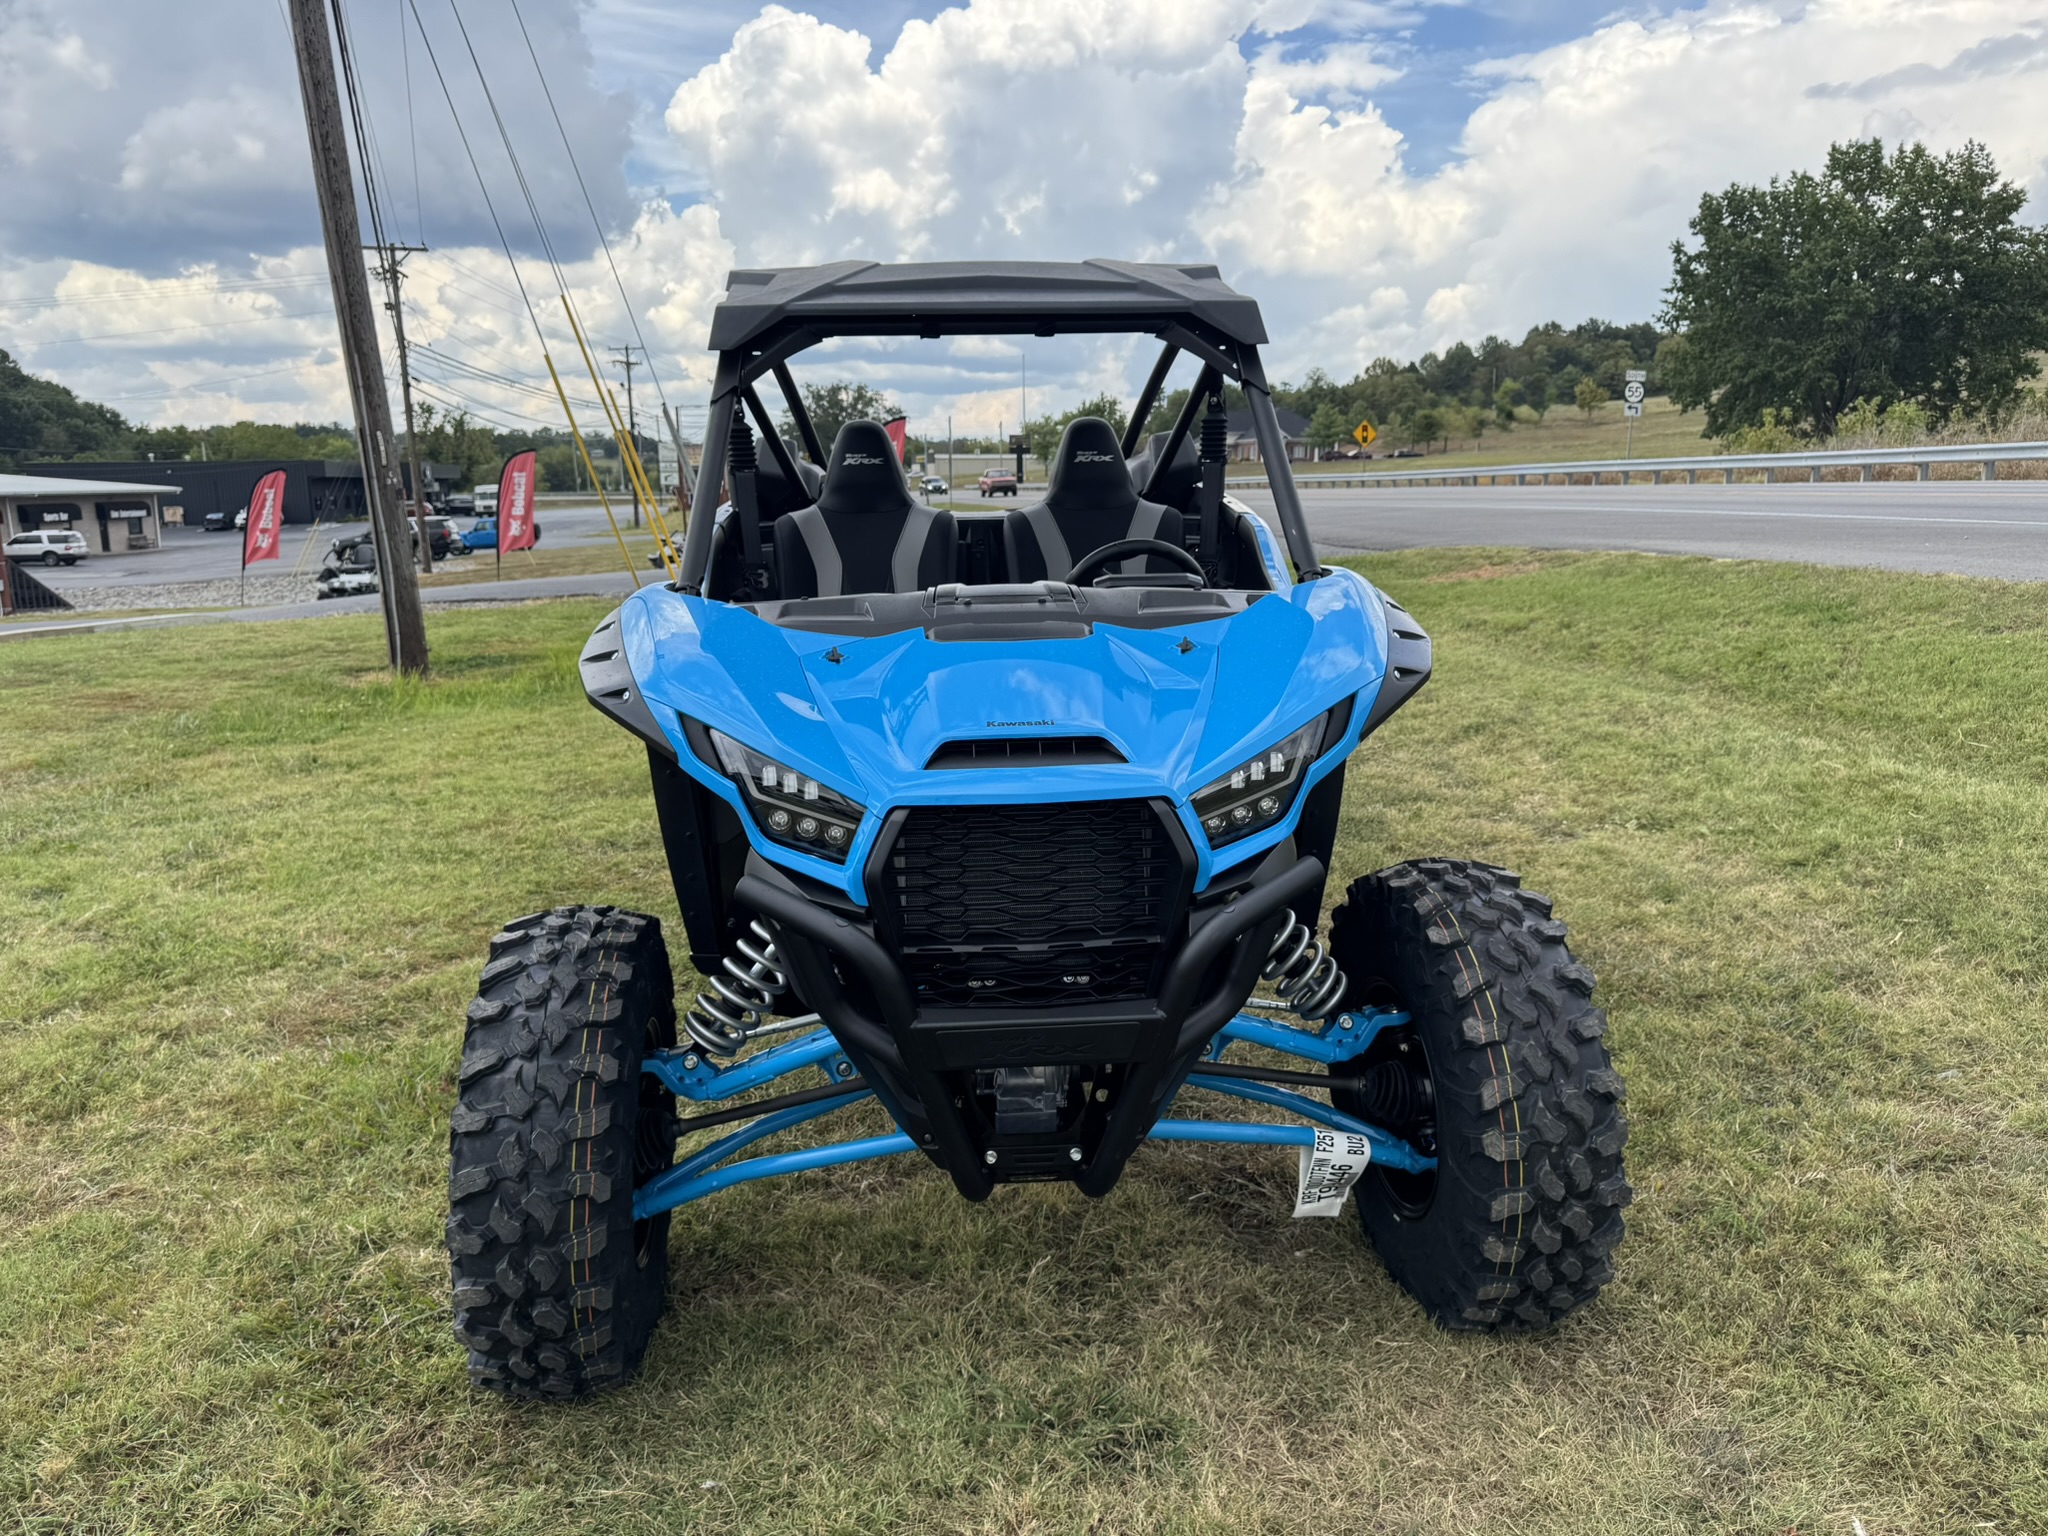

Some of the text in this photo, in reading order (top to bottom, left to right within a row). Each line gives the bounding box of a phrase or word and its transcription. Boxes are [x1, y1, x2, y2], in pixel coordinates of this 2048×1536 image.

[1627, 386, 1642, 398] 55
[842, 457, 885, 465] KRX
[1073, 454, 1114, 463] KRX
[511, 471, 527, 516] Bobcat
[260, 488, 275, 529] Bobcat
[987, 719, 1055, 728] Kawasaki
[1315, 1130, 1334, 1153] F251
[1347, 1135, 1365, 1155] BU2
